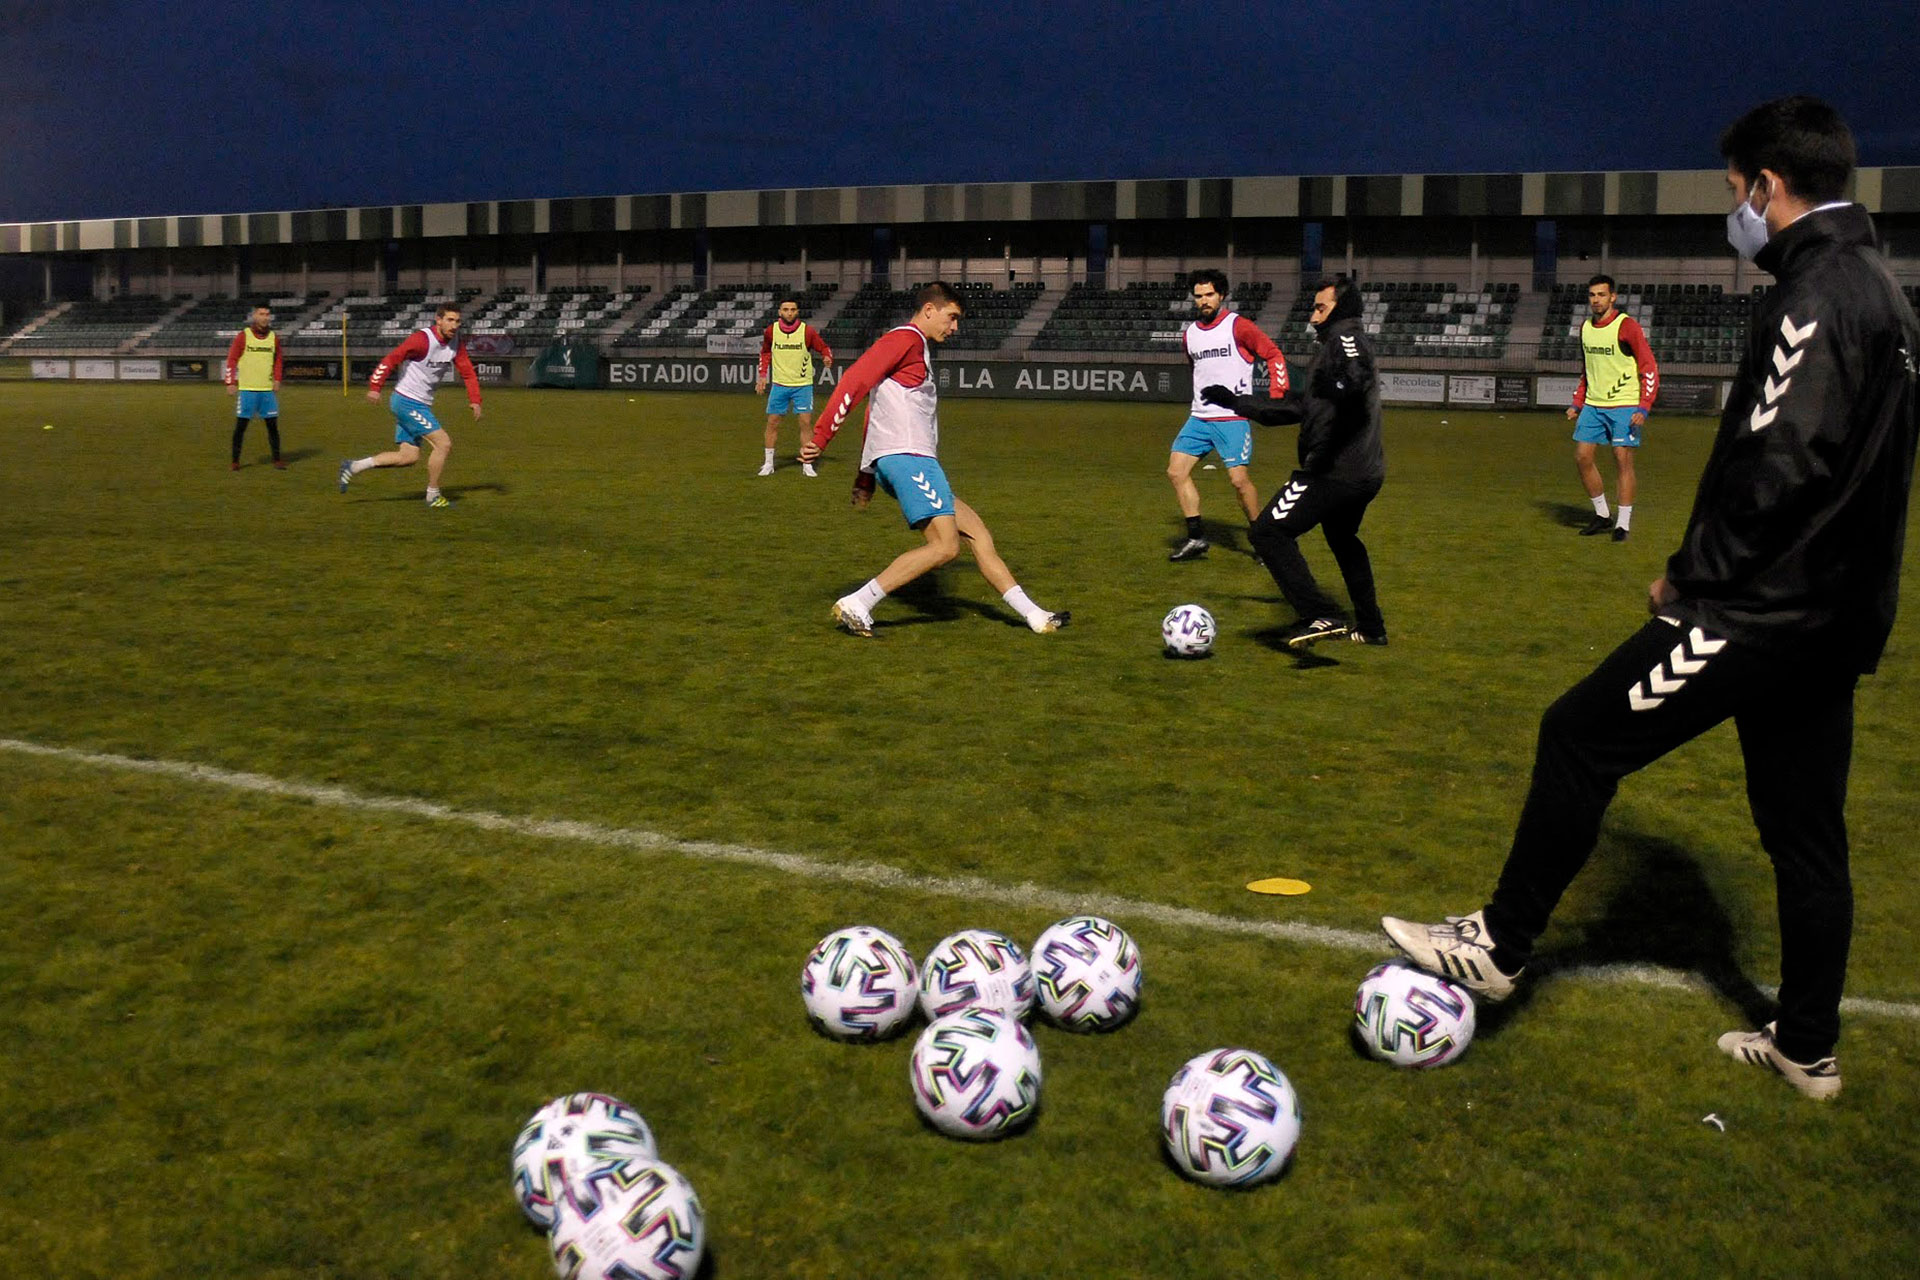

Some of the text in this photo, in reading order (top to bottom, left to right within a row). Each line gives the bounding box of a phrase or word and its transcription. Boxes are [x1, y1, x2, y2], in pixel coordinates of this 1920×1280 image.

[773, 341, 803, 350] hummel
[609, 363, 709, 384] ESTADIO
[959, 367, 995, 389] LA
[1015, 368, 1149, 392] ALBUERA
[1392, 376, 1442, 388] Recoletas
